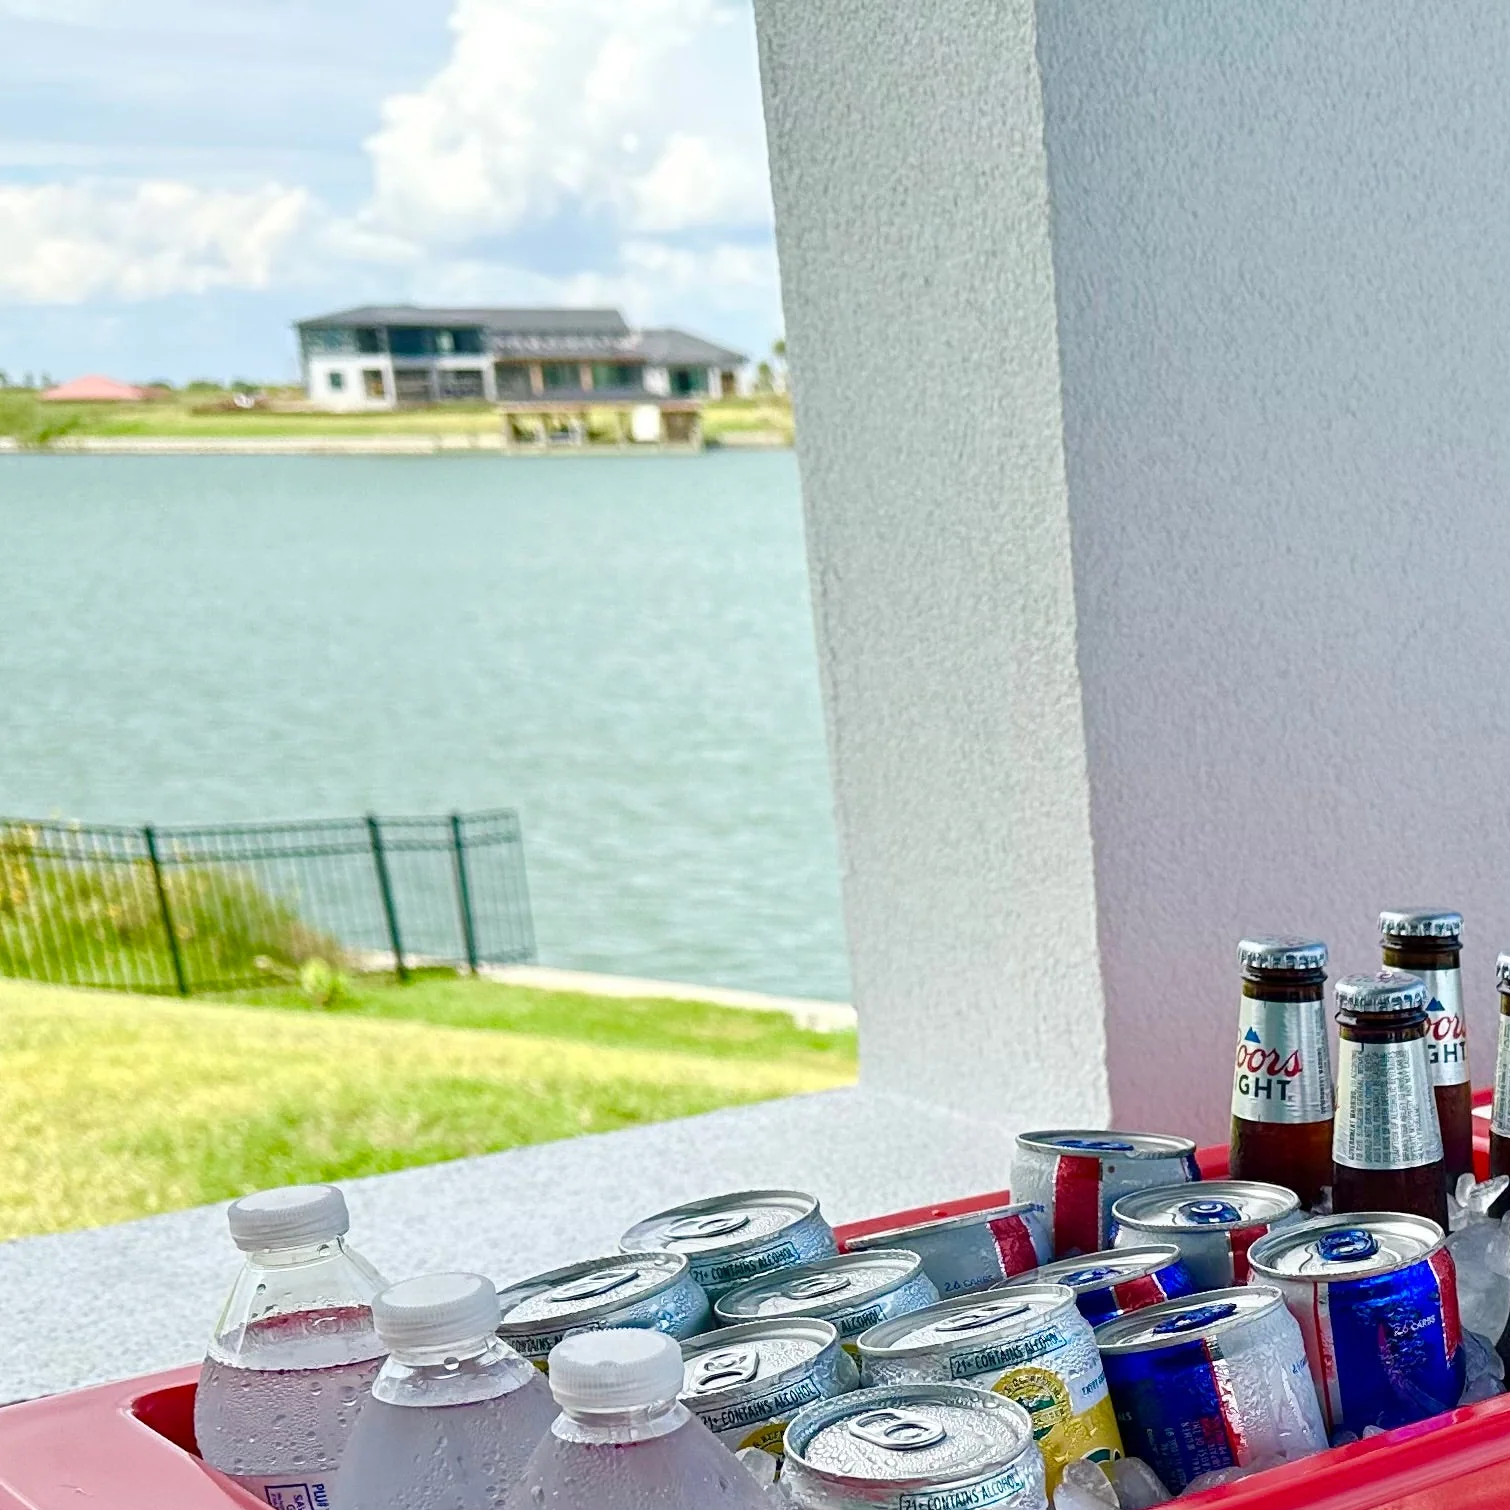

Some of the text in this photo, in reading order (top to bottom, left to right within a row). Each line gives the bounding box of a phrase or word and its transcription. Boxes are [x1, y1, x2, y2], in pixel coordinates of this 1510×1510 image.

[1237, 1044, 1303, 1078] oors
[1238, 1074, 1292, 1101] GHT
[711, 1260, 756, 1280] CONTAINS
[974, 1344, 1023, 1369] CONTAINS
[721, 1399, 773, 1426] CONTAINS
[981, 1475, 1024, 1501] ALCOHOL
